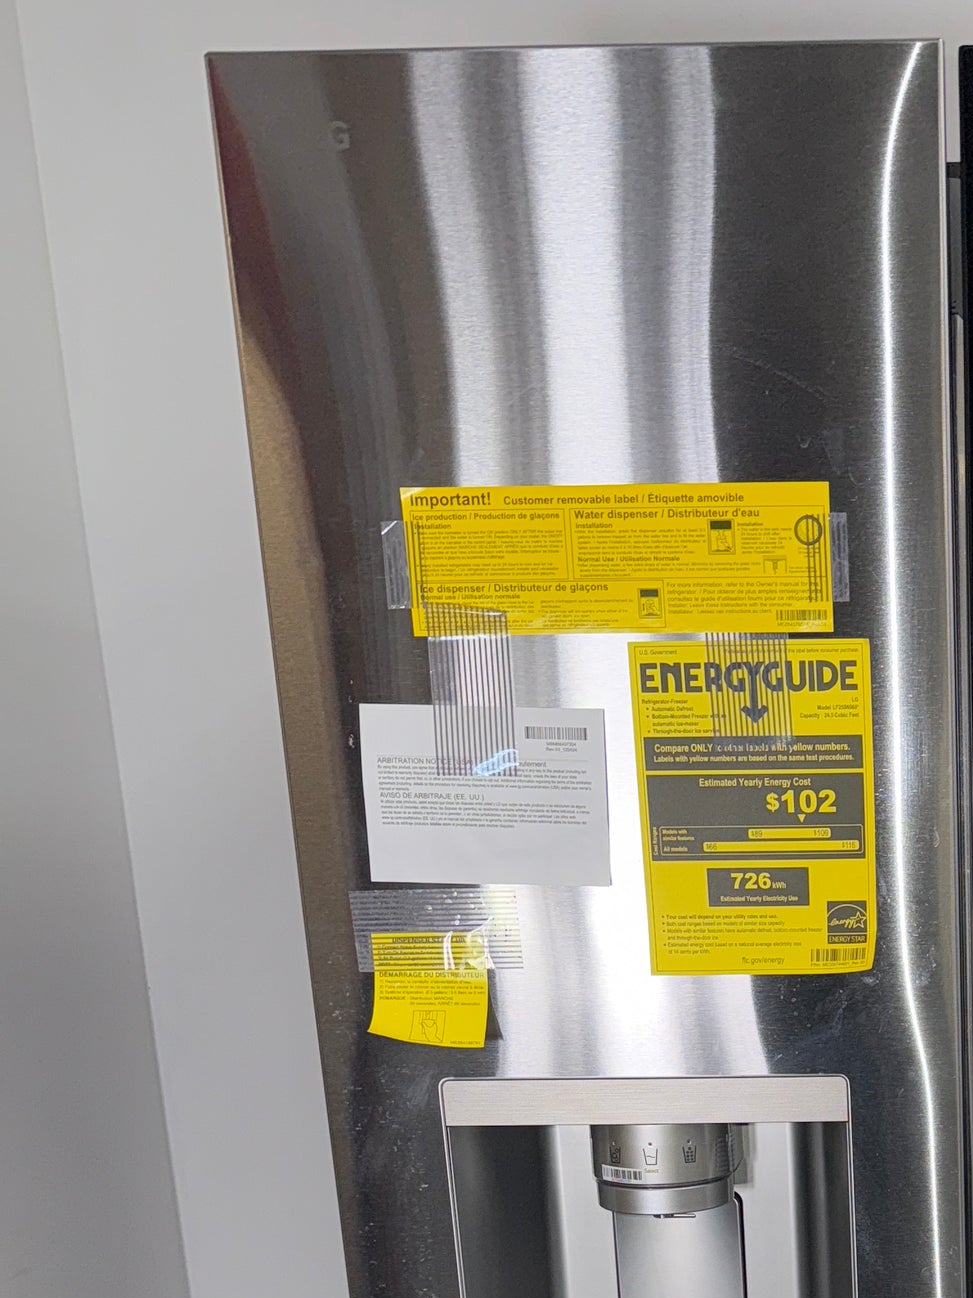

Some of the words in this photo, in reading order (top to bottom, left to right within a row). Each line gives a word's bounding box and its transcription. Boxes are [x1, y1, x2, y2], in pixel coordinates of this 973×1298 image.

[409, 491, 491, 509] Important!
[503, 495, 553, 505] Customer
[557, 494, 610, 504] removable
[613, 494, 639, 504] label
[647, 491, 694, 505] Étiquette
[697, 492, 744, 502] amovible
[425, 513, 467, 522] production
[473, 511, 516, 520] Production
[517, 511, 528, 519] de
[529, 511, 560, 521] glaçons
[574, 510, 604, 519] Water
[606, 509, 658, 520] dispenser
[667, 508, 729, 518] Distributeur
[731, 508, 760, 517] d'eau
[419, 584, 434, 593] Ice
[436, 584, 486, 594] dispenser
[493, 583, 552, 592] Distributeur
[554, 583, 567, 591] de
[569, 582, 609, 593] glaçons
[639, 659, 858, 693] ENERGYGUIDE
[654, 743, 689, 754] Compare
[690, 743, 713, 753] ONLY
[771, 742, 787, 751] with
[788, 742, 814, 753] yellow
[814, 742, 851, 751] numbers.
[377, 756, 424, 765] ARBITRATION
[653, 755, 674, 763] Labels
[688, 755, 709, 764] yellow
[709, 754, 736, 762] numbers
[748, 754, 767, 762] based
[818, 754, 855, 762] procedures.
[698, 778, 737, 787] Estimated
[738, 778, 763, 789] Yearly
[764, 777, 791, 788] Energy
[792, 776, 811, 786] Cost
[379, 791, 401, 799] AVISO
[413, 792, 452, 800] ARBITRAJE
[765, 788, 837, 814] $102
[750, 830, 763, 838] $89
[730, 872, 772, 890] 726
[772, 881, 787, 889] kWh
[746, 895, 762, 903] Yearly
[762, 894, 788, 903] Electricity
[828, 935, 851, 943] ENERGY
